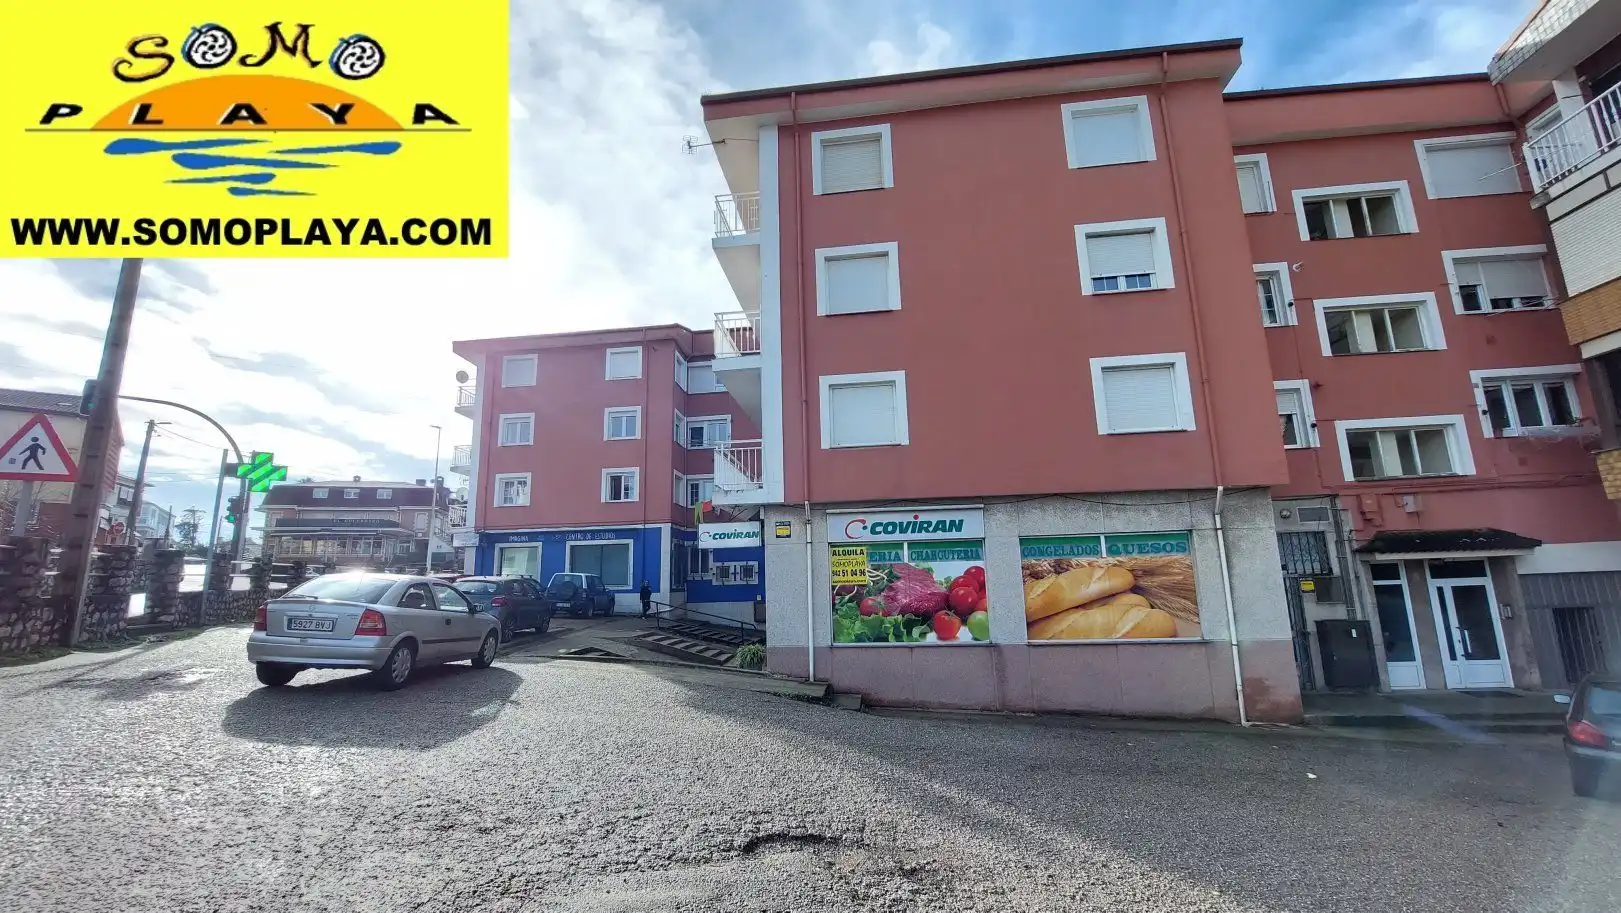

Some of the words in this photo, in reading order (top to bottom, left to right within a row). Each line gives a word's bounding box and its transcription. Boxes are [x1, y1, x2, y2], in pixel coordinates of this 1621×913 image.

[869, 514, 964, 536] COVIRAN
[712, 528, 761, 540] COVIRAN
[831, 549, 865, 557] ALQUILA
[1022, 544, 1100, 557] CONGELADOS
[1110, 541, 1187, 555] QUESOS
[859, 568, 867, 577] 96
[292, 620, 313, 629] 5927
[315, 621, 331, 630] BVJ
